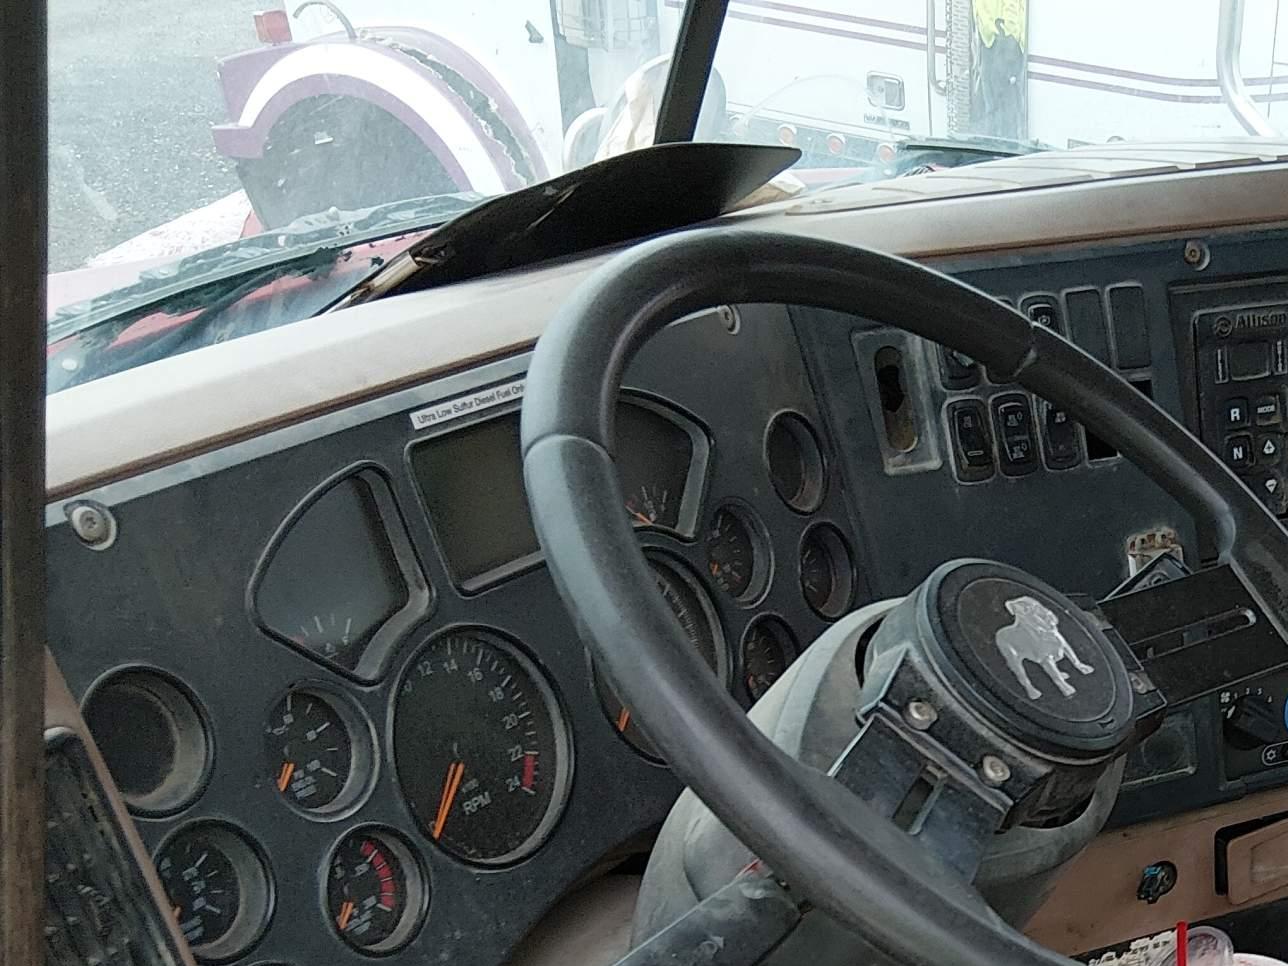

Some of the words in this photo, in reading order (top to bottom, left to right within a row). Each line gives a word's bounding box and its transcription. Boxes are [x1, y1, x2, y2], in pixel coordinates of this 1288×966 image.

[1234, 311, 1287, 329] Allison
[416, 414, 437, 424] Ultra
[436, 409, 453, 419] Low
[496, 388, 511, 401] Fuel
[1230, 408, 1240, 422] R
[1233, 446, 1243, 460] N
[417, 661, 433, 677] 12
[442, 659, 459, 674] 14
[467, 667, 484, 683] 16
[488, 687, 504, 702] 18
[501, 713, 519, 730] 20
[508, 745, 525, 762] 22
[505, 775, 521, 793] 24
[462, 791, 492, 815] RPM
